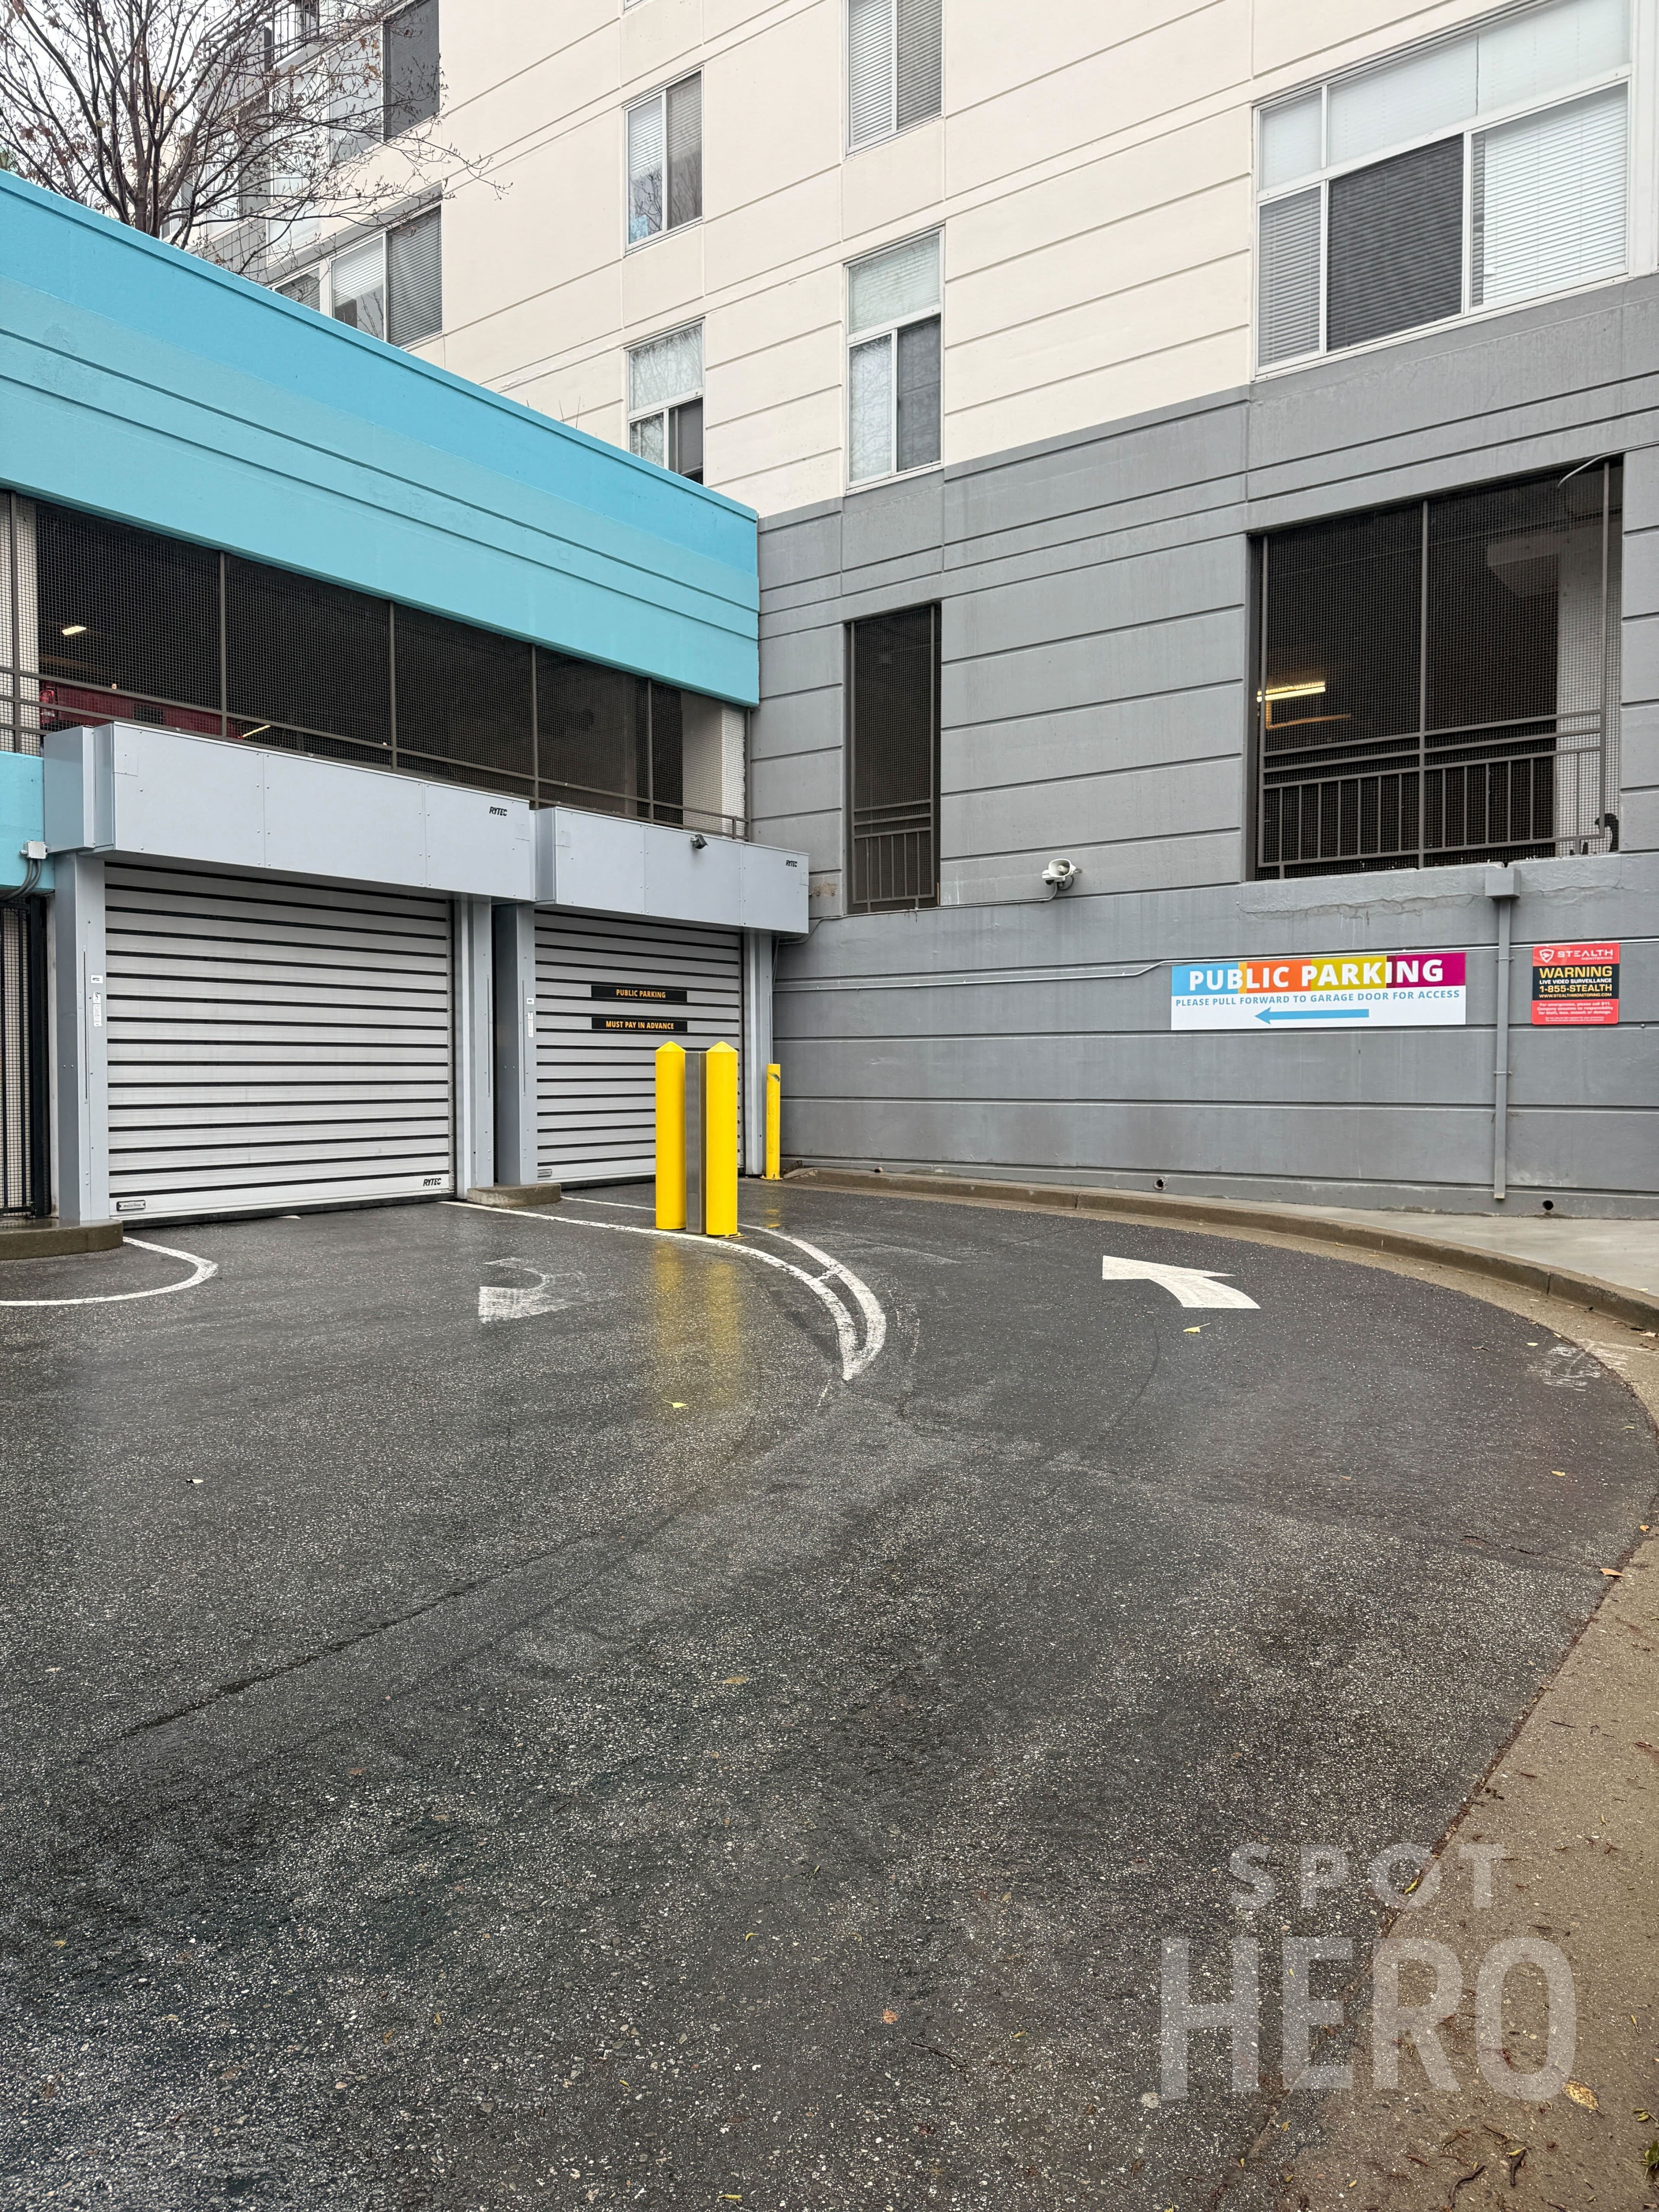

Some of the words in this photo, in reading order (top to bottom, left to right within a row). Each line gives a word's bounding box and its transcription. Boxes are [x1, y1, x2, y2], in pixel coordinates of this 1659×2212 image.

[489, 807, 508, 816] RYTEC
[1557, 949, 1613, 958] STEALTH
[1189, 966, 1290, 991] PUBLIC
[1301, 959, 1443, 988] PARKING
[1539, 966, 1612, 979] WARNING
[1539, 984, 1612, 993] 1-855-STEALTH
[1240, 996, 1290, 1004] FORWARD
[1310, 993, 1354, 1002] GARAGE
[1393, 991, 1414, 999] FOR
[1418, 990, 1459, 999] ACCESS
[423, 1178, 442, 1186] RYTEC
